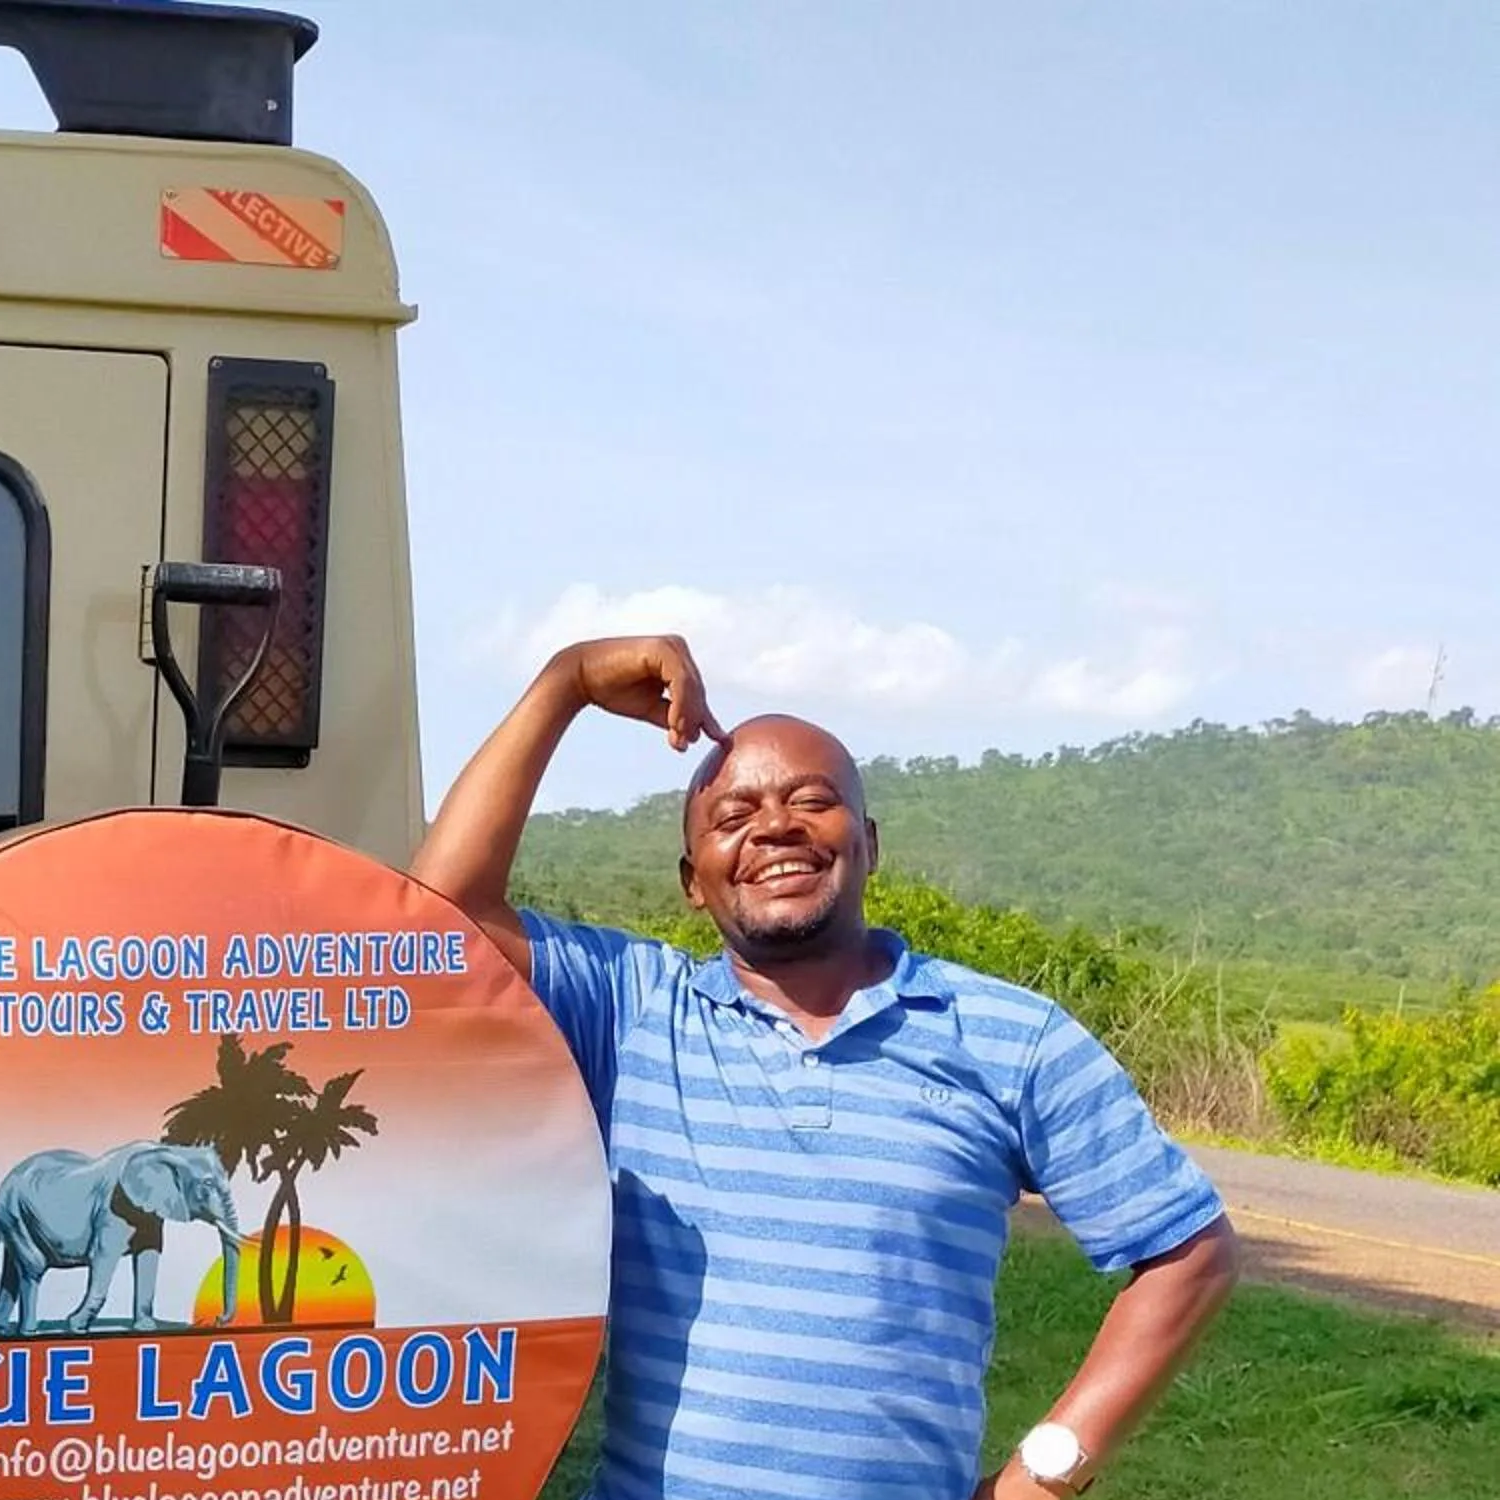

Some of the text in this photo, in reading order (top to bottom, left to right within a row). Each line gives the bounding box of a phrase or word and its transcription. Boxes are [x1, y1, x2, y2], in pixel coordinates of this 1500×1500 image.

[32, 934, 207, 980] LAGOON
[222, 931, 468, 979] ADVENTURE
[139, 991, 170, 1035] &
[184, 987, 332, 1034] TRAVEL
[344, 985, 411, 1029] LTD
[136, 1327, 518, 1421] LAGOON
